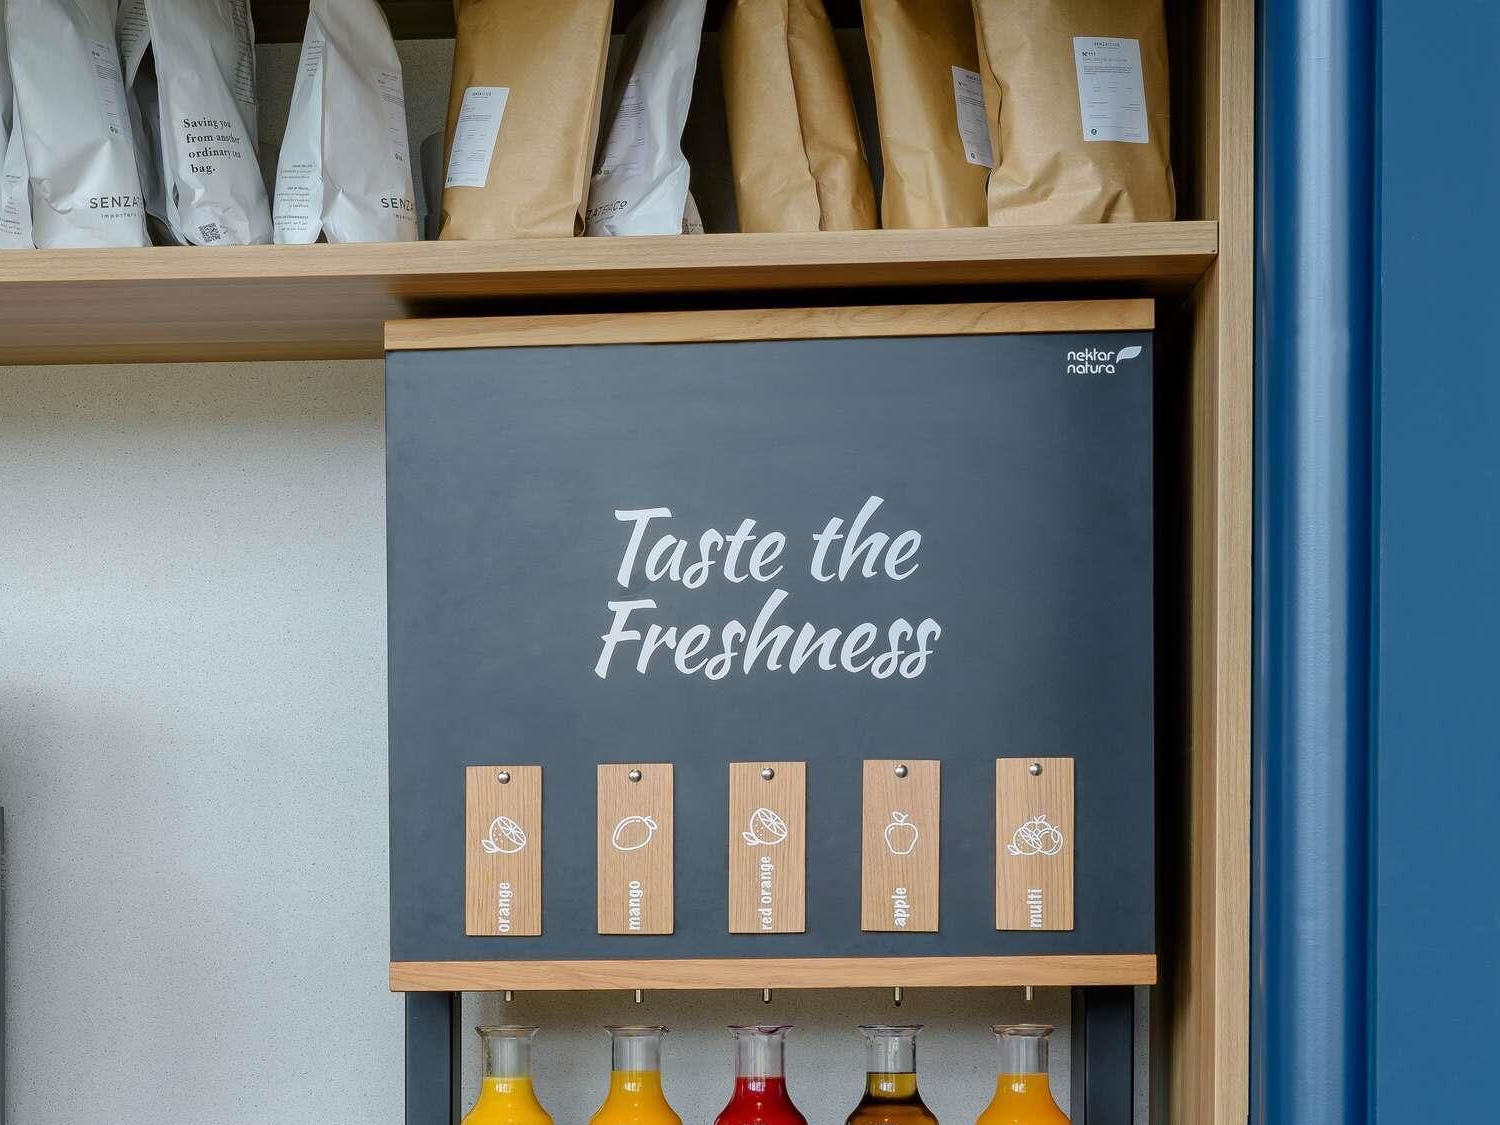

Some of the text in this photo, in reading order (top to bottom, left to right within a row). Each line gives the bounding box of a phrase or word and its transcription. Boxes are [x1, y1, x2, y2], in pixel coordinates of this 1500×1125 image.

[183, 117, 218, 130] Saving
[186, 133, 214, 144] from
[188, 147, 231, 159] ordinary
[191, 164, 216, 175] bag.
[1067, 347, 1116, 362] nektar
[1067, 360, 1116, 374] natura
[614, 495, 922, 590] Taste the
[594, 588, 942, 681] Freshness
[499, 882, 515, 933] orange
[628, 880, 643, 931] mango
[757, 855, 774, 931] red orange
[891, 887, 911, 927] apple
[1026, 888, 1043, 928] multi
